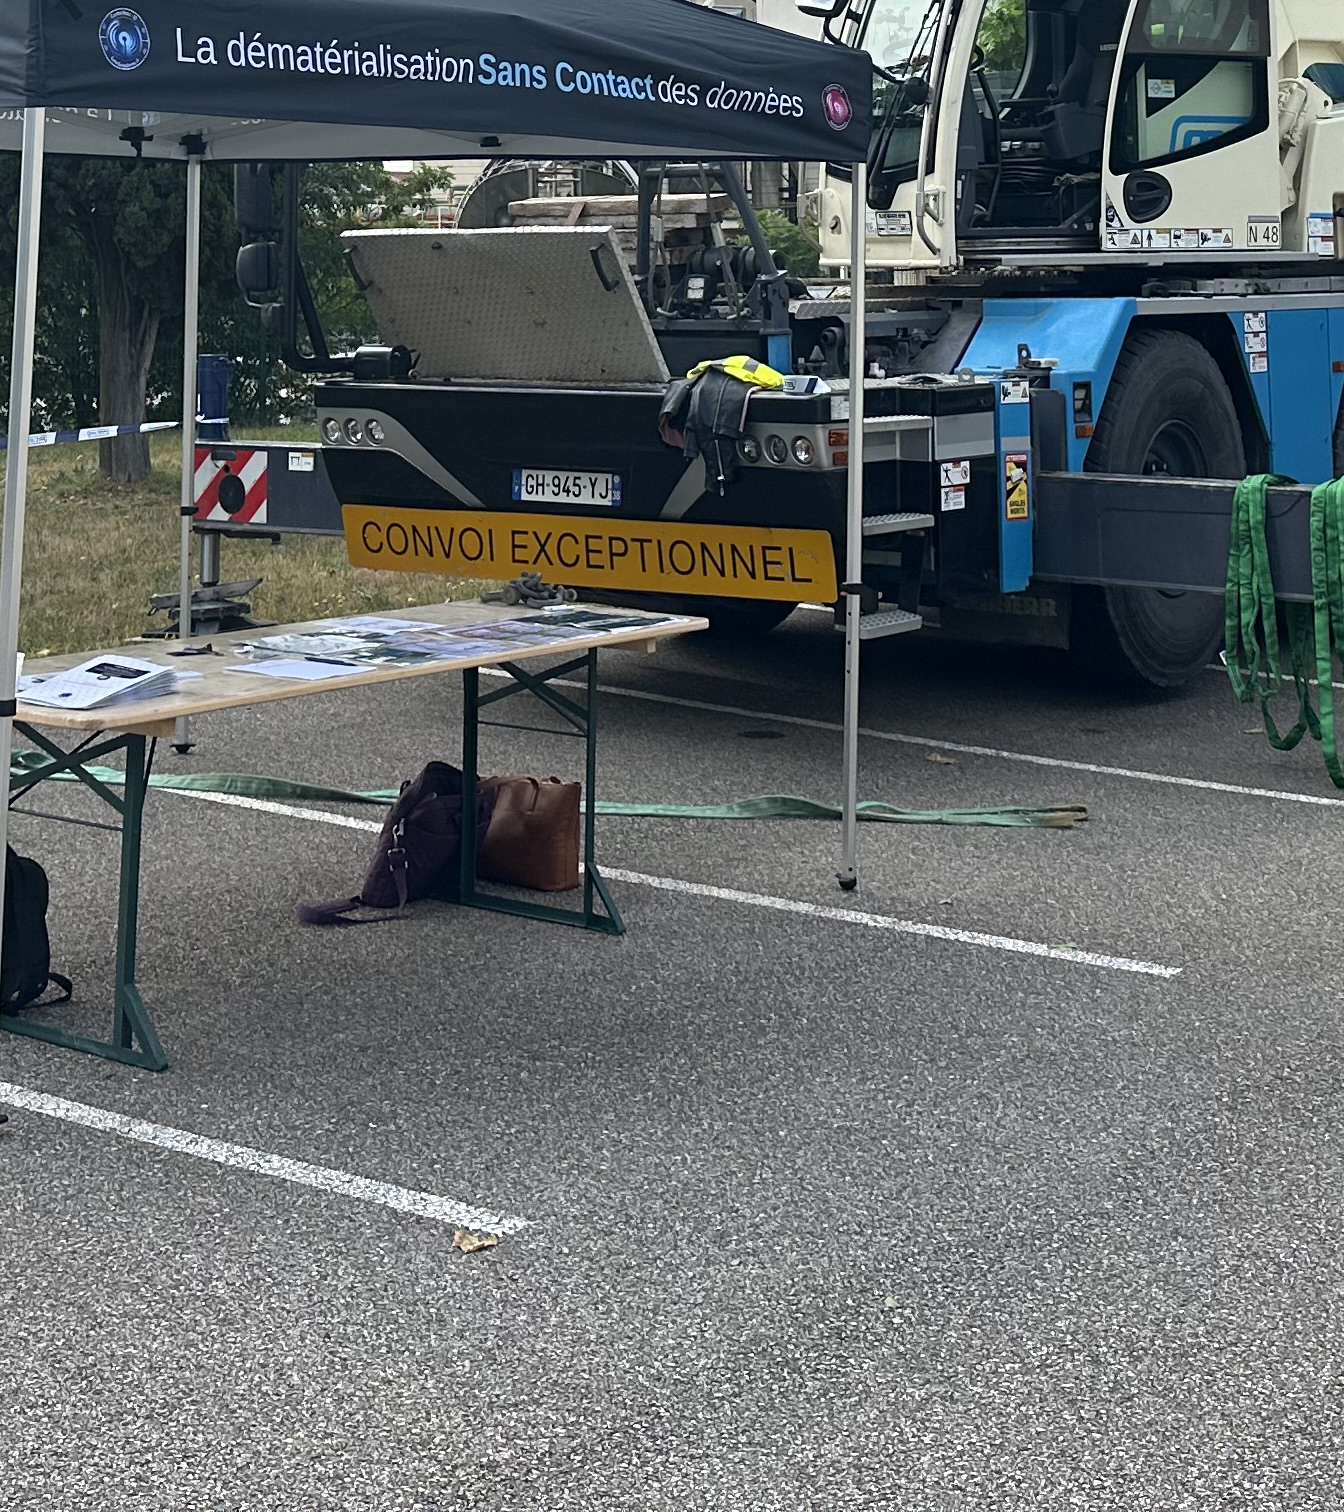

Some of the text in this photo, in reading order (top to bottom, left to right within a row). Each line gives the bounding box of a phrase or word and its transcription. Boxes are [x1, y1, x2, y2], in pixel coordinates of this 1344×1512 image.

[175, 26, 805, 119] La dématérialisation Sans Contact des données
[1249, 225, 1279, 244] N 48
[524, 473, 610, 500] GH-945-YJ
[360, 520, 814, 584] CONVOI EXCEPTIONNEL
